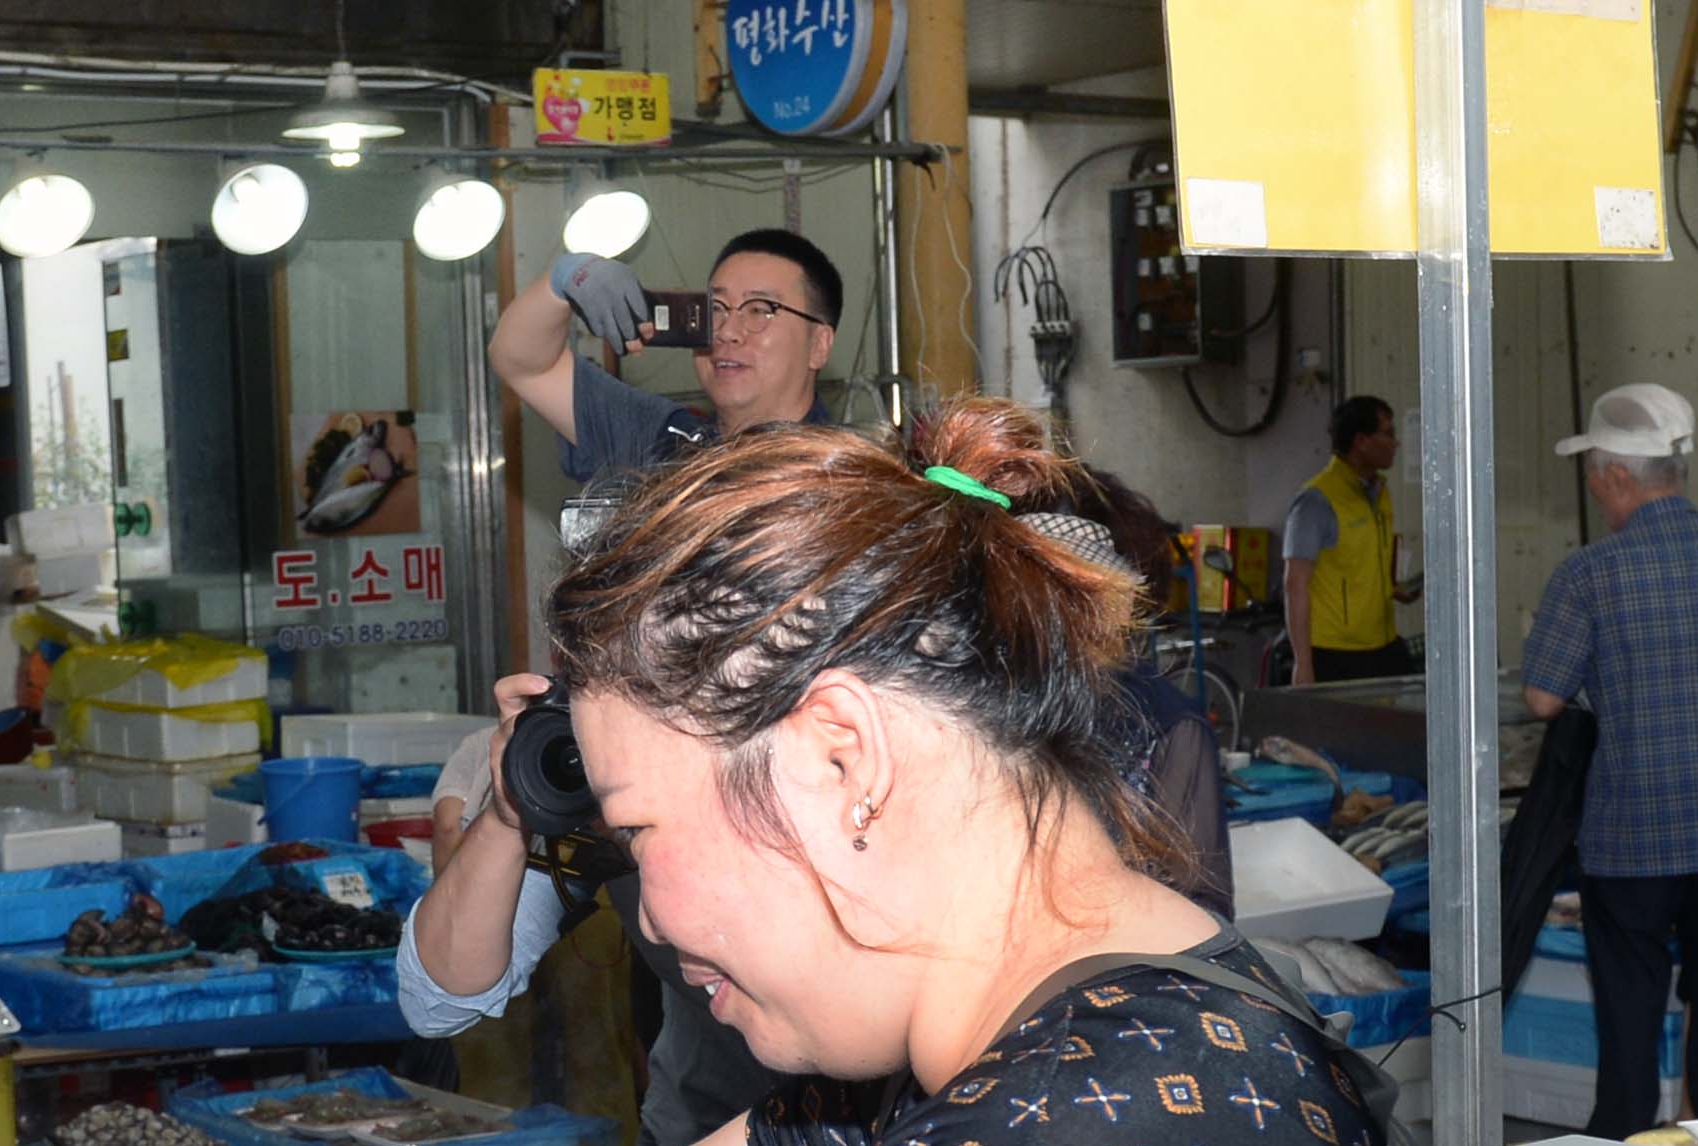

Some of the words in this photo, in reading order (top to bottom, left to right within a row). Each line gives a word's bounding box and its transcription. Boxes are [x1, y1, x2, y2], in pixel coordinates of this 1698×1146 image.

[593, 95, 657, 121] 가맹점
[275, 546, 444, 608] 도.소매
[280, 619, 447, 648] 010-5188-2220
